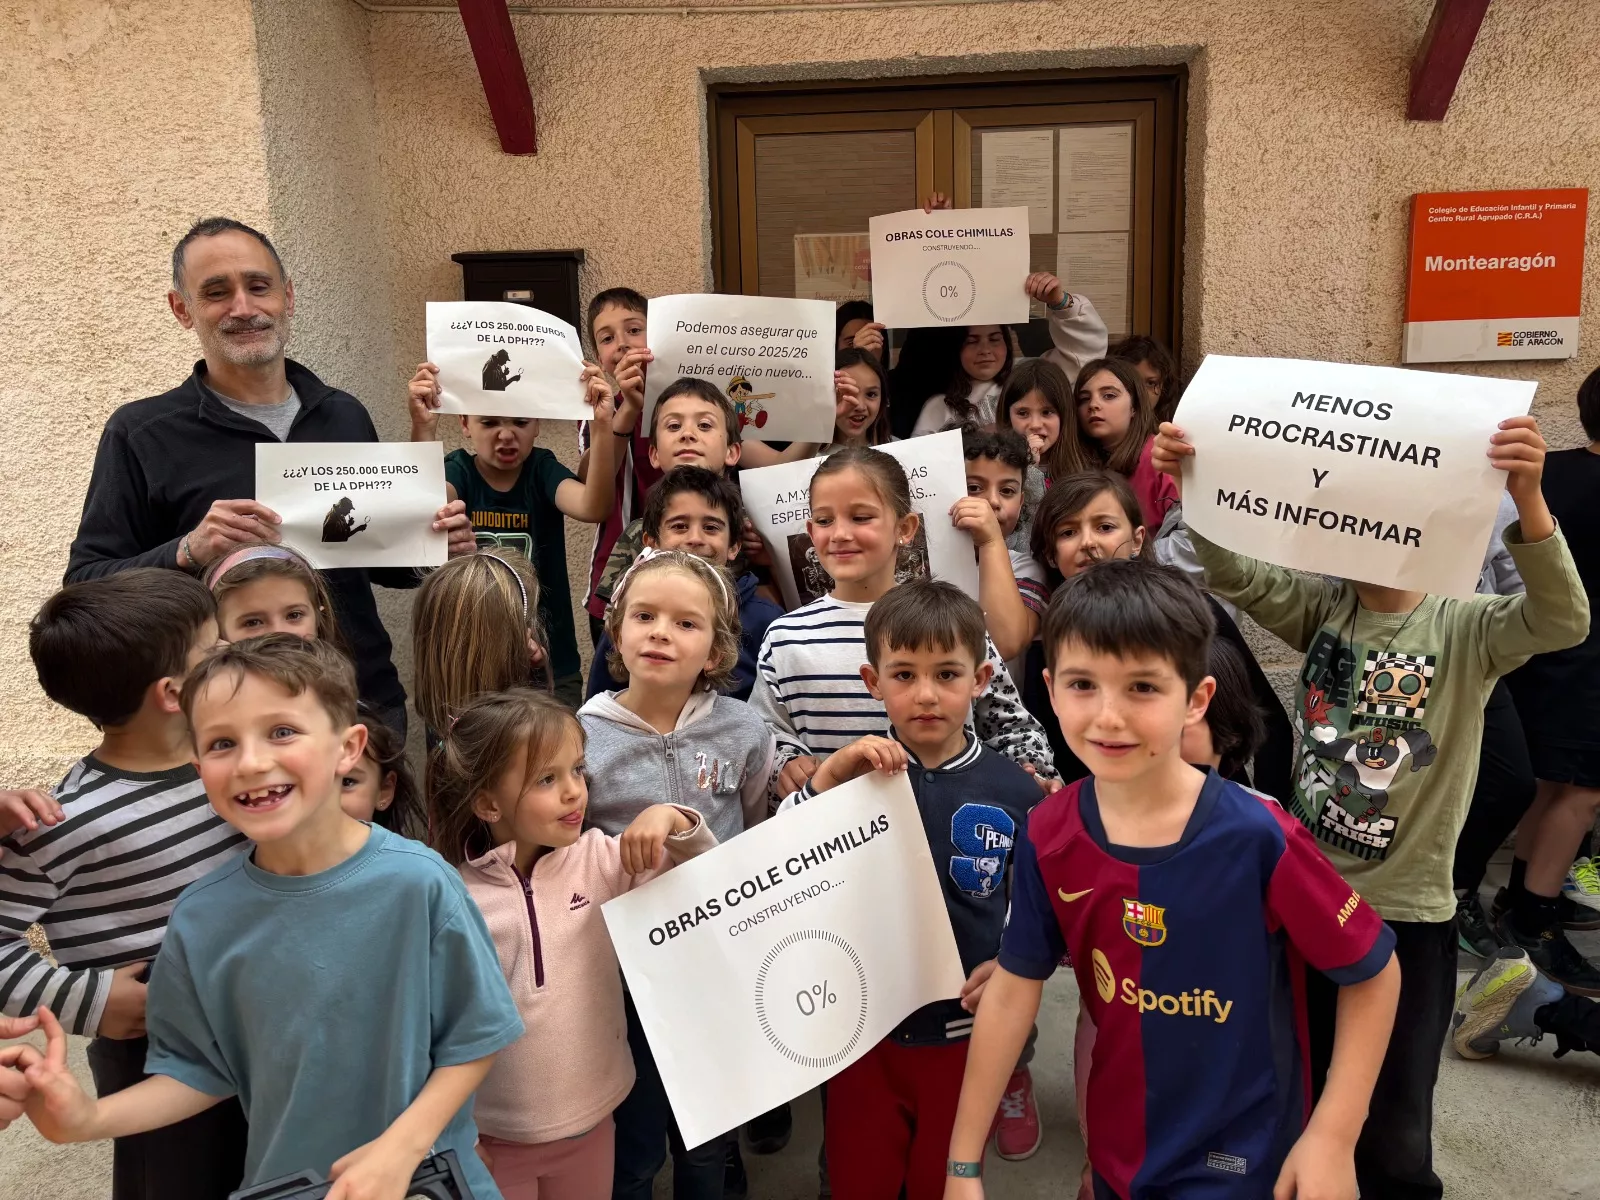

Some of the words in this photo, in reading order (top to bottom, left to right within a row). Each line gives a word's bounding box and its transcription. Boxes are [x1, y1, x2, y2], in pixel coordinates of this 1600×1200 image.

[1428, 206, 1457, 215] Colegio
[1458, 205, 1468, 213] de
[1470, 204, 1509, 213] Educación
[1511, 203, 1537, 211] Infantil
[1538, 204, 1543, 212] y
[1545, 202, 1577, 210] Primaria
[1428, 215, 1454, 223] Centro
[1455, 214, 1476, 222] Rural
[1477, 213, 1513, 222] Agrupado
[1514, 212, 1543, 221] (C.R.A.)
[885, 230, 923, 242] OBRAS
[925, 229, 954, 239] COLE
[956, 228, 1014, 238] CHIMILLAS
[1425, 252, 1556, 272] Montearagón
[940, 285, 959, 298] 0%
[450, 320, 473, 330] ¿¿¿Y
[475, 321, 495, 329] LOS
[497, 322, 534, 332] 250.000
[536, 325, 566, 339] EUROS
[676, 320, 738, 335] Podemos
[740, 326, 795, 339] asegurar
[796, 328, 818, 340] que
[1512, 330, 1558, 339] GOBIERNO
[477, 334, 491, 342] DE
[493, 335, 505, 344] LA
[507, 336, 545, 347] DPH???
[686, 344, 703, 354] en
[706, 343, 718, 355] el
[720, 346, 756, 357] curso
[758, 345, 808, 359] 2025/26
[677, 363, 715, 375] habrá
[717, 364, 763, 378] edificio
[765, 368, 812, 379] nuevo...
[1291, 391, 1394, 421] MENOS
[1228, 414, 1441, 468] PROCRASTINAR
[283, 466, 308, 478] ¿¿¿Y
[311, 466, 334, 476] LOS
[336, 466, 379, 475] 250.000
[381, 465, 419, 475] EUROS
[1312, 468, 1330, 489] Y
[314, 482, 330, 491] DE
[332, 482, 347, 491] LA
[349, 481, 392, 490] DPH???
[1216, 488, 1268, 516] MÁS
[1274, 501, 1423, 548] INFORMAR
[1321, 814, 1391, 848] TRICK
[648, 897, 722, 946] OBRAS
[724, 865, 783, 907] COLE
[784, 814, 889, 876] CHIMILLAS
[728, 880, 845, 937] CONSTRUYENDO....
[795, 979, 838, 1017] 0%
[1120, 977, 1234, 1024] Spotify
